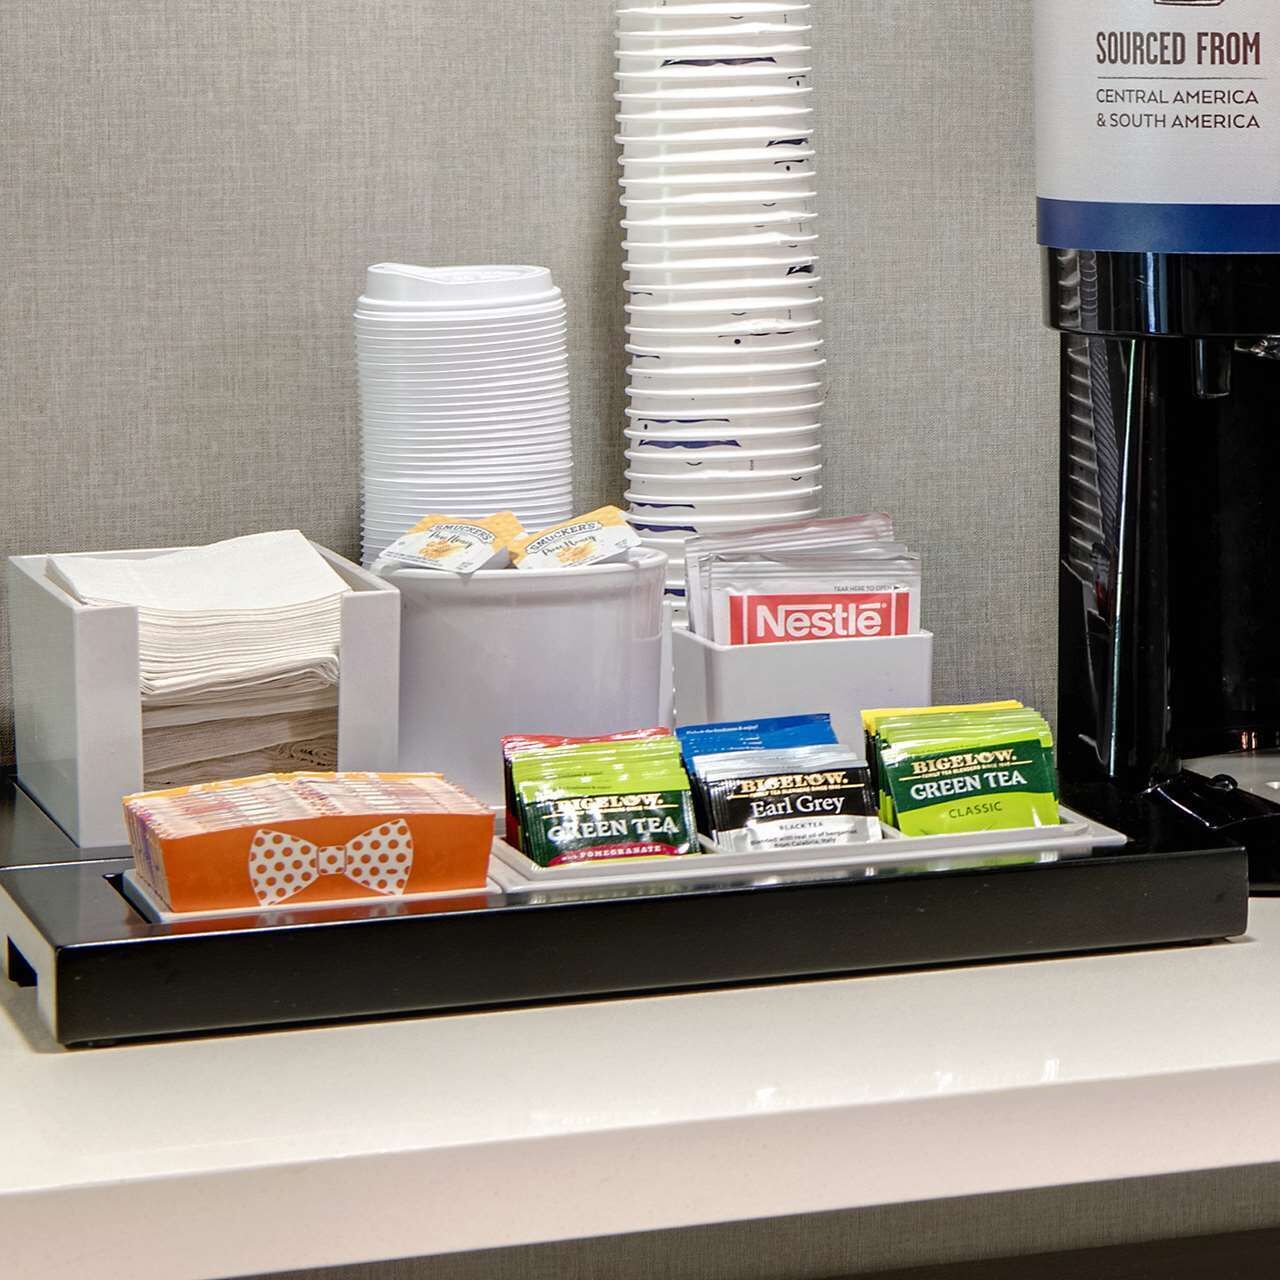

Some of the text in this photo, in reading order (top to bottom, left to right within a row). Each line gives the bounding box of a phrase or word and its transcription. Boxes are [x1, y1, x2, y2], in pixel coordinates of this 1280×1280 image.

[1097, 32, 1260, 65] SOURCED FROM
[1097, 89, 1258, 104] CENTRAL AMERICA
[1097, 113, 1260, 128] & SOUTH AMERICA
[910, 774, 981, 801] GREEN
[983, 770, 1028, 788] TEA
[750, 795, 846, 819] Earl Grey
[948, 801, 1003, 819] CLASSIC
[547, 816, 680, 843] GREEN TEA
[579, 845, 662, 859] POMEGRANATE
